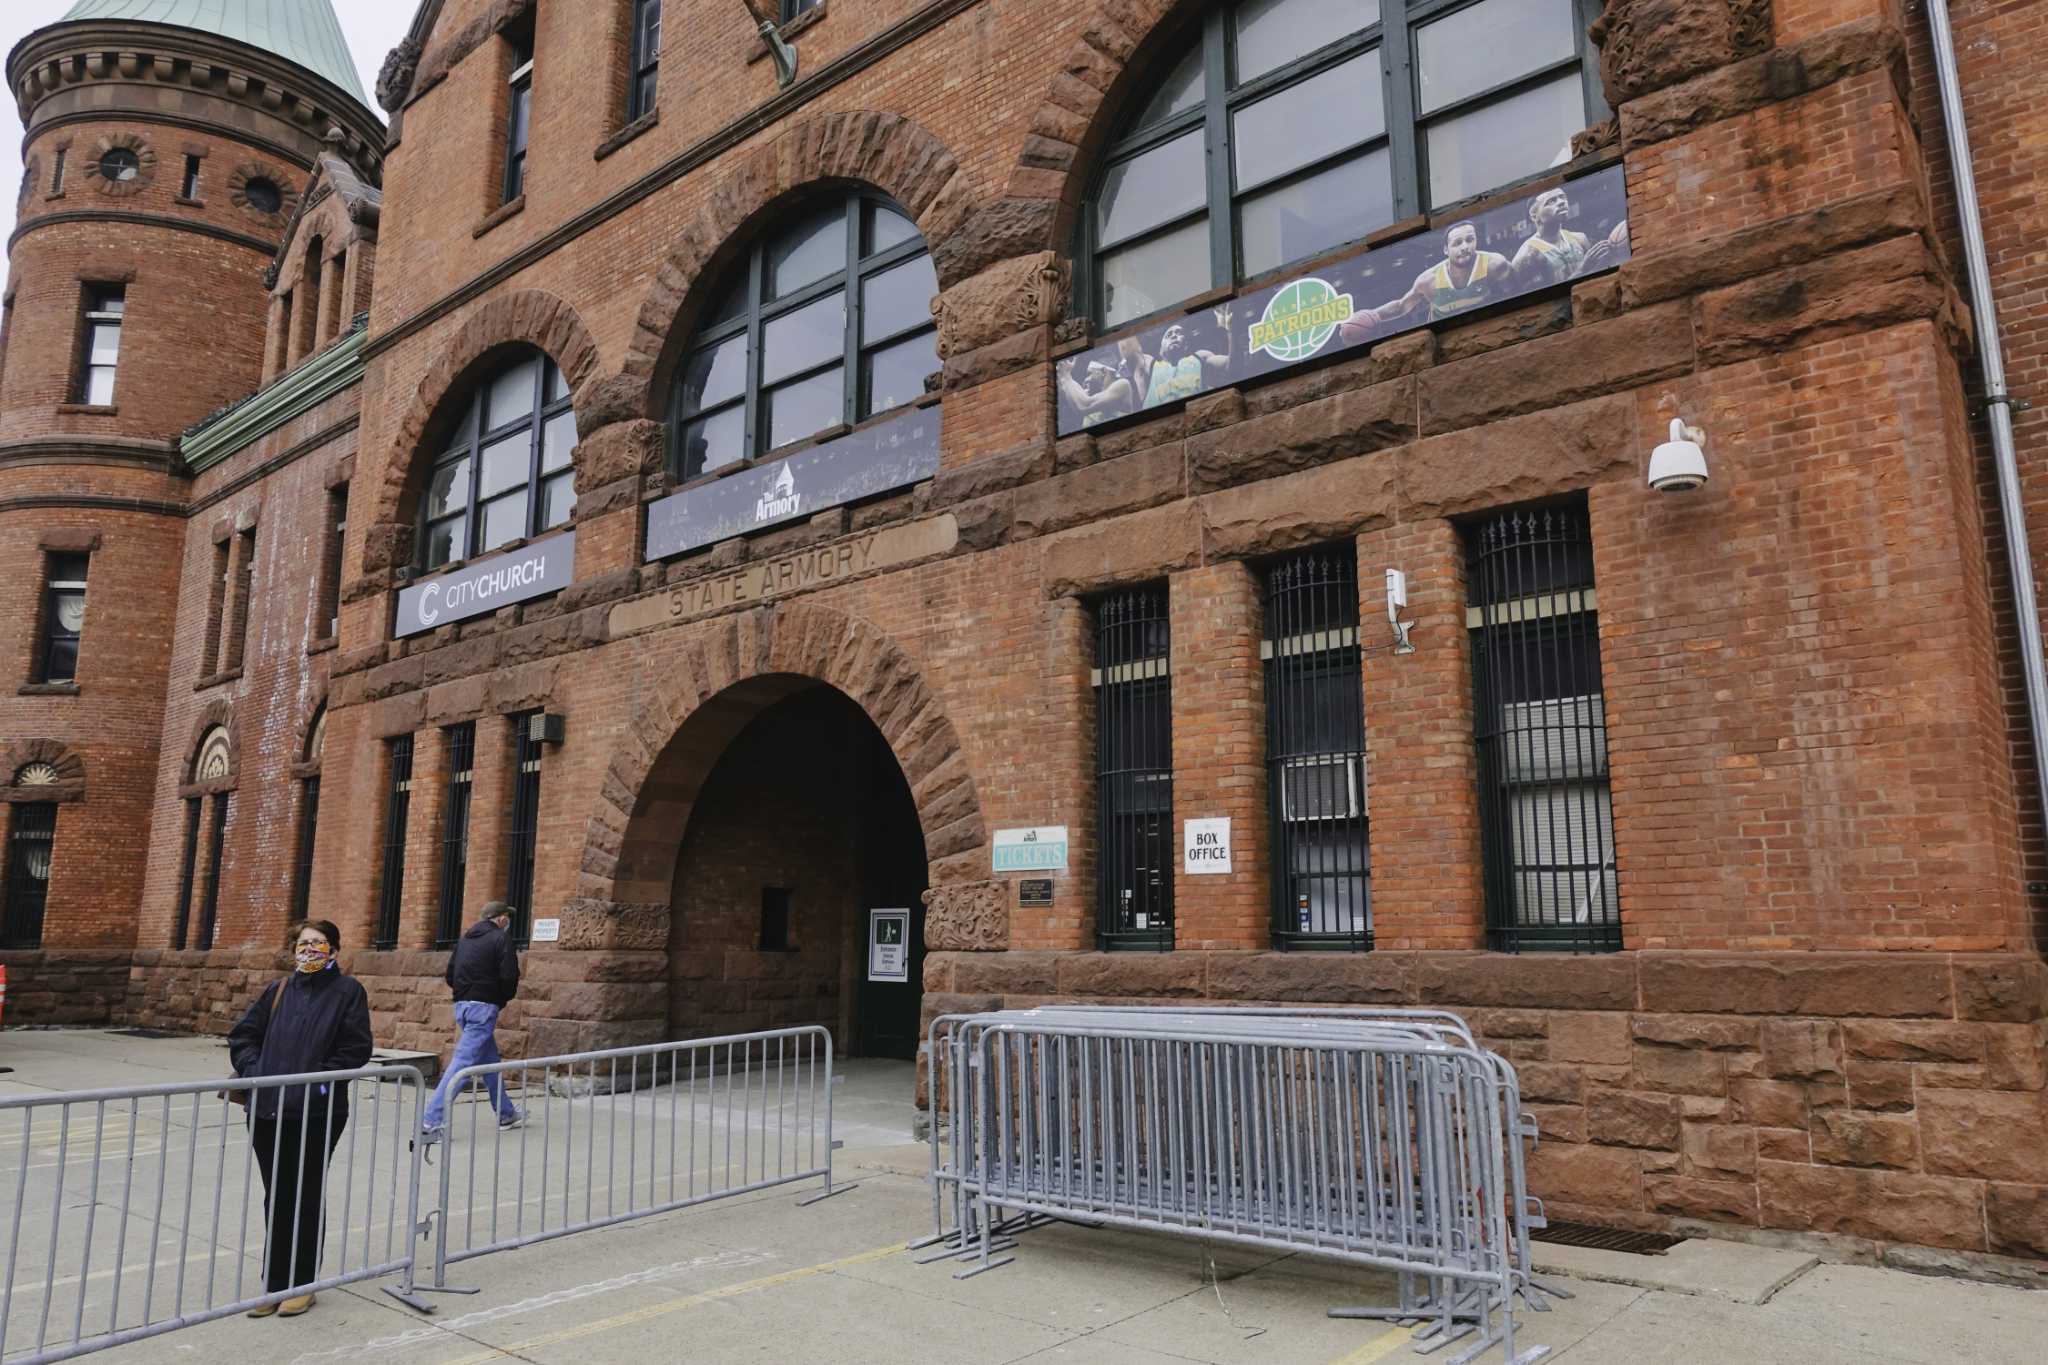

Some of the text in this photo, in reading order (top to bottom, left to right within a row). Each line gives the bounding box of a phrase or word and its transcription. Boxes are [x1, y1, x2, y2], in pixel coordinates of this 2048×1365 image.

[1251, 297, 1350, 350] PATROONS
[755, 493, 801, 522] Armory
[669, 573, 748, 616] STATE
[1196, 832, 1218, 845] BOX
[997, 844, 1062, 865] TICKETS
[1189, 847, 1226, 860] OFFICE
